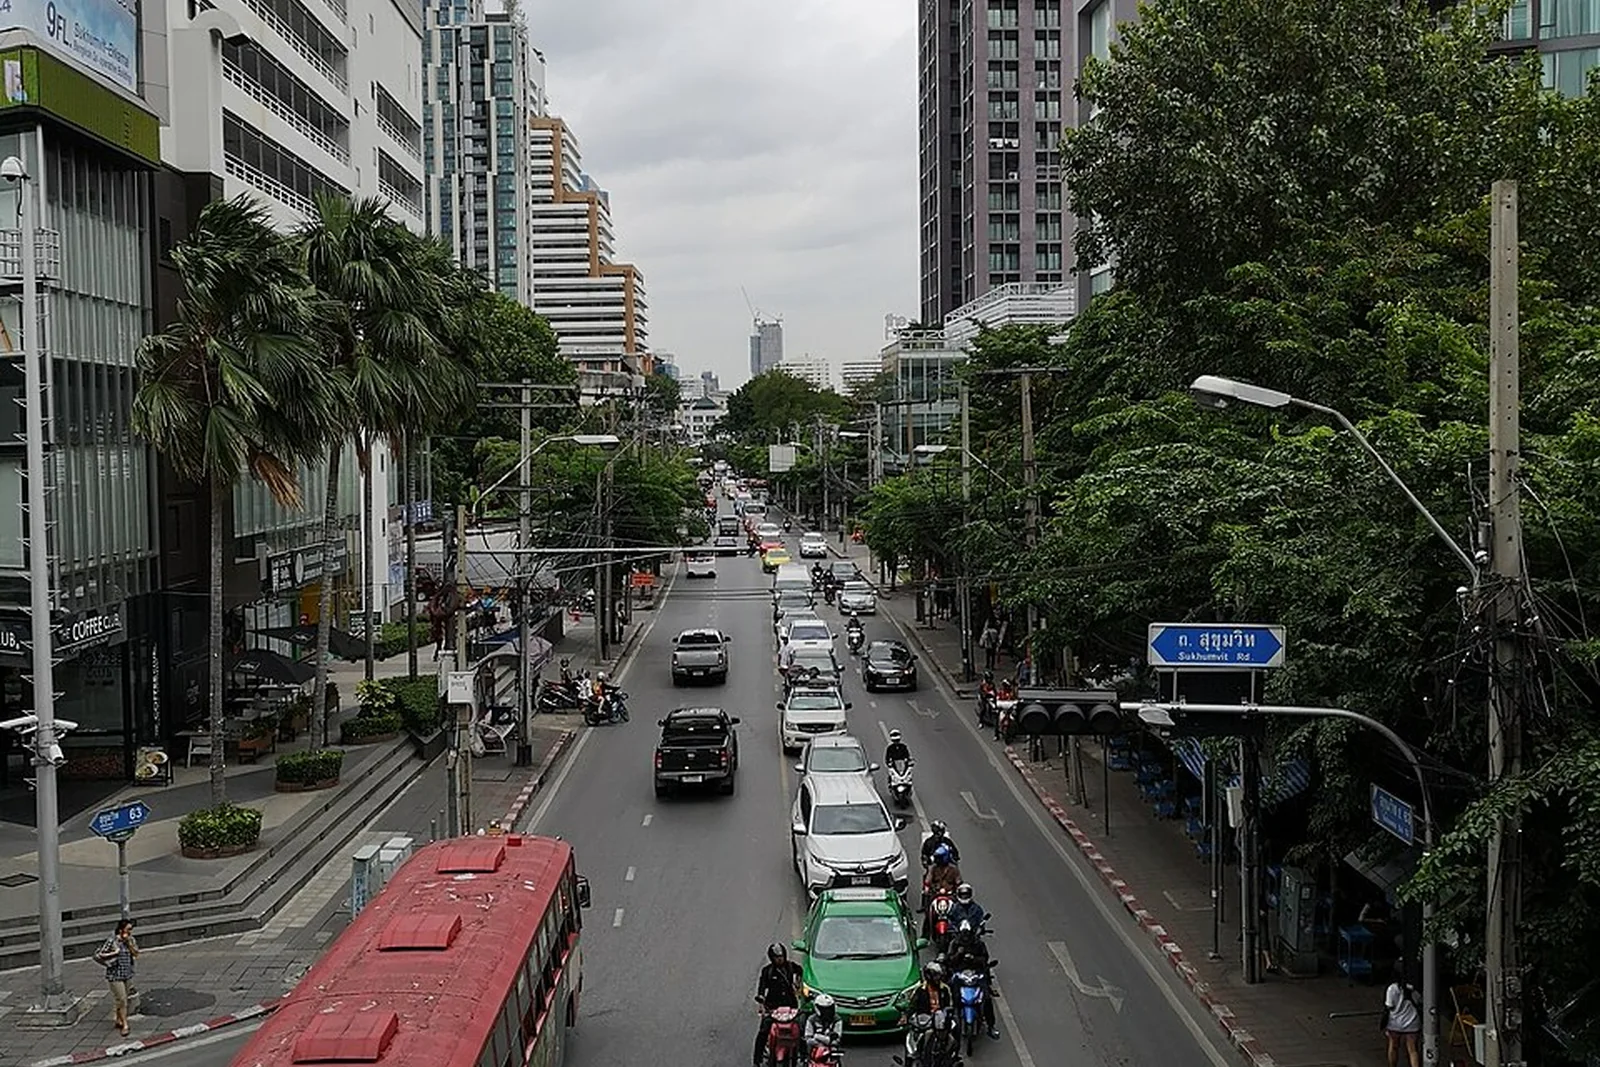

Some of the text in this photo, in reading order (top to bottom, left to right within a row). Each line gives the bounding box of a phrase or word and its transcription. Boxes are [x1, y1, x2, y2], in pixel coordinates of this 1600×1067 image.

[72, 615, 103, 641] COFFEE
[1199, 629, 1255, 652] สุขุมวิท
[1177, 651, 1255, 661] Sukhumvit Rd.
[129, 807, 143, 820] 63
